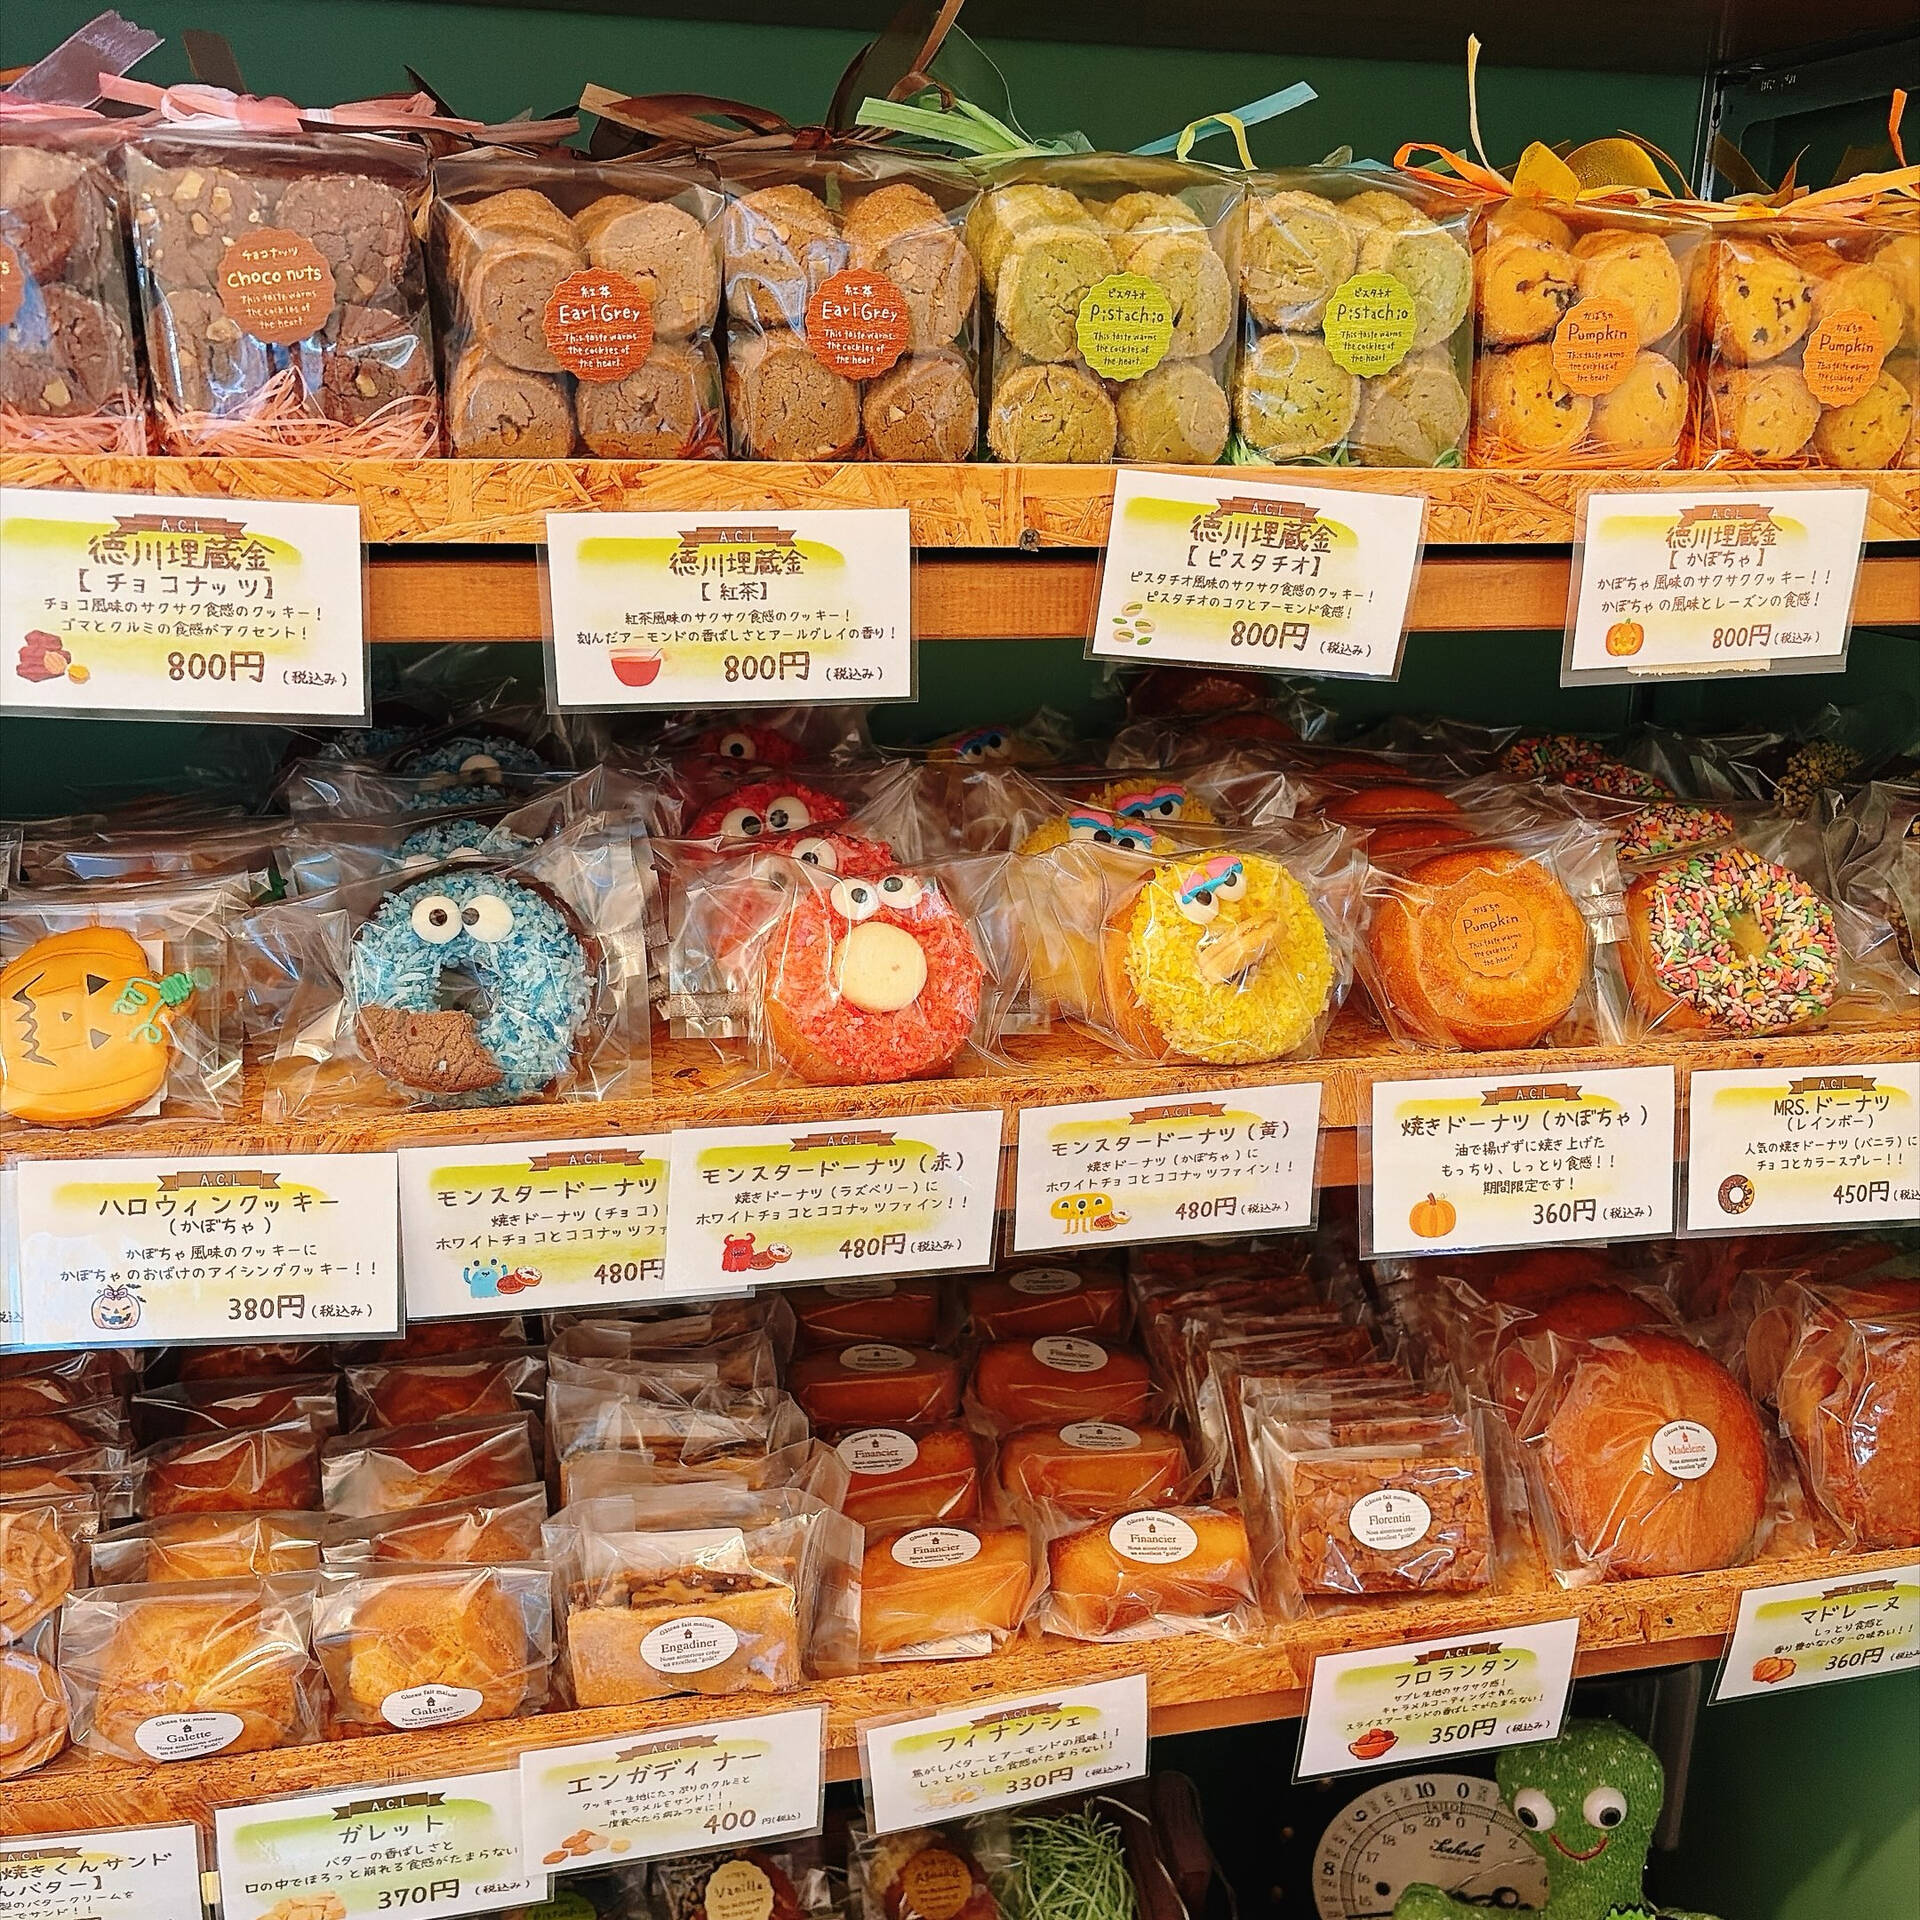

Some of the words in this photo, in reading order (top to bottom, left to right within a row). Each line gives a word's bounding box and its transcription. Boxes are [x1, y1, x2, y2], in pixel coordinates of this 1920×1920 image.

[242, 246, 298, 261] チョコナッツ
[286, 265, 323, 281] nuts
[581, 284, 612, 298] 紅茶
[844, 284, 873, 297] 紅茶
[1108, 288, 1146, 300] ピスタチオ
[1354, 287, 1392, 298] ピスタチオ
[559, 304, 596, 324] Earl
[600, 303, 640, 322] Grey
[822, 301, 856, 320] Earl
[861, 303, 898, 322] Grey
[1090, 304, 1164, 323] Pistachio
[1336, 304, 1408, 322] Pistachio
[564, 333, 583, 344] This
[585, 333, 607, 342] taste
[610, 332, 637, 340] warms
[1568, 323, 1628, 344] Pumpkin
[1820, 334, 1874, 356] Pumpkin
[621, 345, 631, 355] of
[1189, 514, 1338, 553] 徳川埋蔵金
[1665, 522, 1783, 549] 徳川埋蔵金
[88, 534, 276, 572] 徳川埋蔵金
[669, 549, 808, 578] 徳川埋蔵金
[1188, 546, 1321, 576] 【ピスタチオ】
[1669, 548, 1765, 570] 【かぼちゃ】
[78, 568, 274, 600] 【チョコナッツ】
[701, 581, 768, 602] 【紅茶】
[1130, 571, 1374, 603] ピスタチオ風味のサクサク食感のクッキー！
[1597, 570, 1832, 591] かぼちゃ風味のサクサククッキー！！
[44, 597, 322, 621] チョコ風味のサクサク食感のクッキー！
[1146, 591, 1353, 620] ピスタチオのコクとアーモンド食感！
[1601, 592, 1820, 614] かぼちゃの風味とレーズンの食感！
[625, 608, 850, 625] 紅茶風味のサクサク食感のクッキー！
[61, 620, 308, 640] ゴマとクルミの食感がアクセント！
[576, 626, 896, 644] 刻んだアーモンドの香ばしさとアールグレイの香り！
[1230, 620, 1310, 652] 800円
[1320, 641, 1372, 658] （税込み）
[1712, 624, 1772, 649] 800円
[1774, 631, 1820, 645] （税込み）
[168, 650, 265, 683] 800円
[283, 670, 348, 687] （税込み）
[724, 651, 811, 682] 800円
[826, 666, 884, 682] （税込み）
[1462, 914, 1519, 934] Pumpkin
[1401, 1105, 1648, 1138] 焼きドーナツ（かぼちゃ）
[1788, 1114, 1874, 1132] （レインボー）
[1051, 1120, 1290, 1156] モンスタードーナツ（黄）
[1455, 1136, 1605, 1158] 油で揚げずに焼き上げた
[1745, 1136, 1918, 1156] 人気の焼きドーナツ（バニラ）に
[702, 1151, 966, 1185] モンスタードーナツ（赤）
[1086, 1148, 1258, 1173] 焼きドーナツ（かぼちゃ）に
[1442, 1156, 1614, 1178] もっちり、しっとり食感！！
[1757, 1153, 1902, 1171] チョコとカラースプレー！！
[1046, 1161, 1293, 1193] ホワイトチョコとココナッツファイン！！
[1483, 1176, 1575, 1195] 期間限定です！
[437, 1178, 658, 1208] モンスタードーナツ
[734, 1180, 938, 1204] 焼きドーナツ（ラズベリー）に
[1833, 1181, 1890, 1204] 450円
[99, 1192, 340, 1218] ハロウィンクッキー
[696, 1196, 968, 1226] ホワイトチョコとココナッツファイン！！
[1175, 1196, 1237, 1220] 480円
[1240, 1201, 1289, 1216] （税込み）
[1533, 1198, 1597, 1224] 360円
[1602, 1205, 1652, 1220] （税込み）
[168, 1216, 272, 1236] （かぼちゃ）
[125, 1242, 318, 1260] かぼちゃ風味のクッキーに
[839, 1233, 906, 1260] 480円
[911, 1238, 962, 1254] （税込み）
[60, 1260, 378, 1282] かぼちゃのおばけのアイシングクッキー！！
[594, 1258, 665, 1285] 480円
[228, 1294, 305, 1321] 380円
[311, 1303, 373, 1318] （税込み）
[1369, 1513, 1411, 1526] Florentin
[913, 1544, 960, 1554] Financier
[1130, 1534, 1176, 1544] Financier
[1801, 1596, 1900, 1624] マドレーヌ
[1814, 1618, 1883, 1637] しっとり食感と
[661, 1640, 718, 1654] Engadiner
[1825, 1647, 1884, 1671] 360円
[1395, 1657, 1520, 1689] フロランタン
[411, 1706, 454, 1716] Galette
[1382, 1688, 1516, 1714] キャラメルコーティングされた
[166, 1730, 212, 1743] Galette
[938, 1716, 1082, 1752] フィナンシェ
[1429, 1718, 1497, 1745] 350円
[1506, 1720, 1552, 1734] （税込み）
[567, 1752, 762, 1796] エンガディナー
[919, 1740, 1114, 1788] しっとりとした食感がたまらない！
[1006, 1766, 1074, 1794] 330円
[1415, 1781, 1436, 1799] 10
[1457, 1782, 1470, 1799] 0
[338, 1815, 444, 1846] ガレット
[703, 1810, 756, 1835] 400
[1424, 1816, 1441, 1828] 20
[326, 1840, 455, 1868] バターの香ばしさと
[0, 1852, 172, 1881] 焼きくんサンド
[245, 1846, 519, 1895] 口の中でほろっと崩れる食感がたまらない
[378, 1878, 460, 1910] 370円
